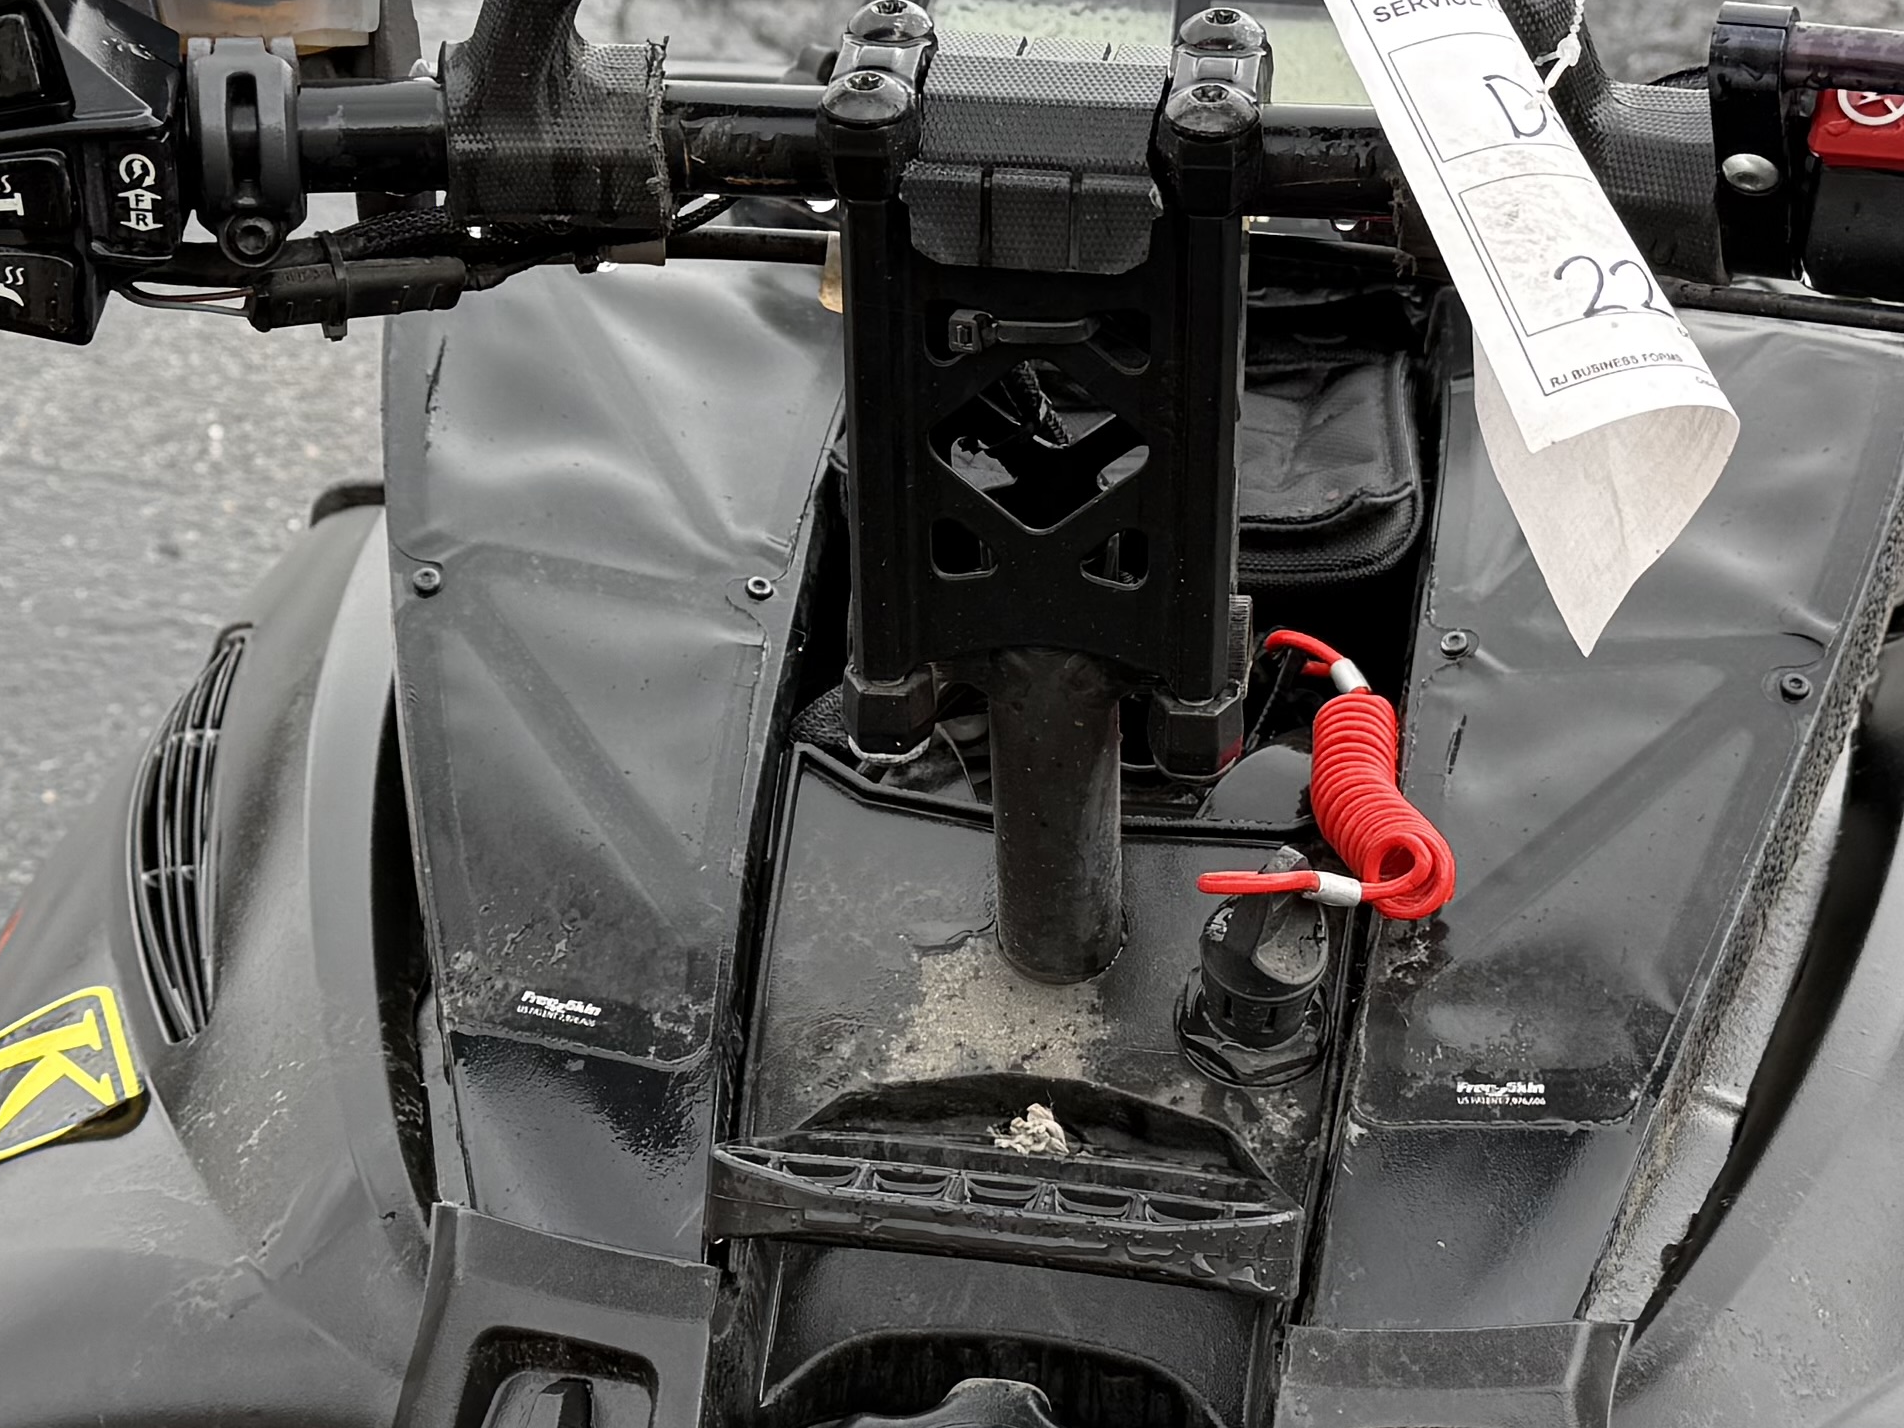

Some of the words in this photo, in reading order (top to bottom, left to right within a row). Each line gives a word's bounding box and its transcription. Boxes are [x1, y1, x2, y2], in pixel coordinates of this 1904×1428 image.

[134, 193, 145, 208] F
[136, 212, 149, 228] R
[1549, 374, 1569, 389] RJ
[1571, 356, 1639, 381] BUSINESS
